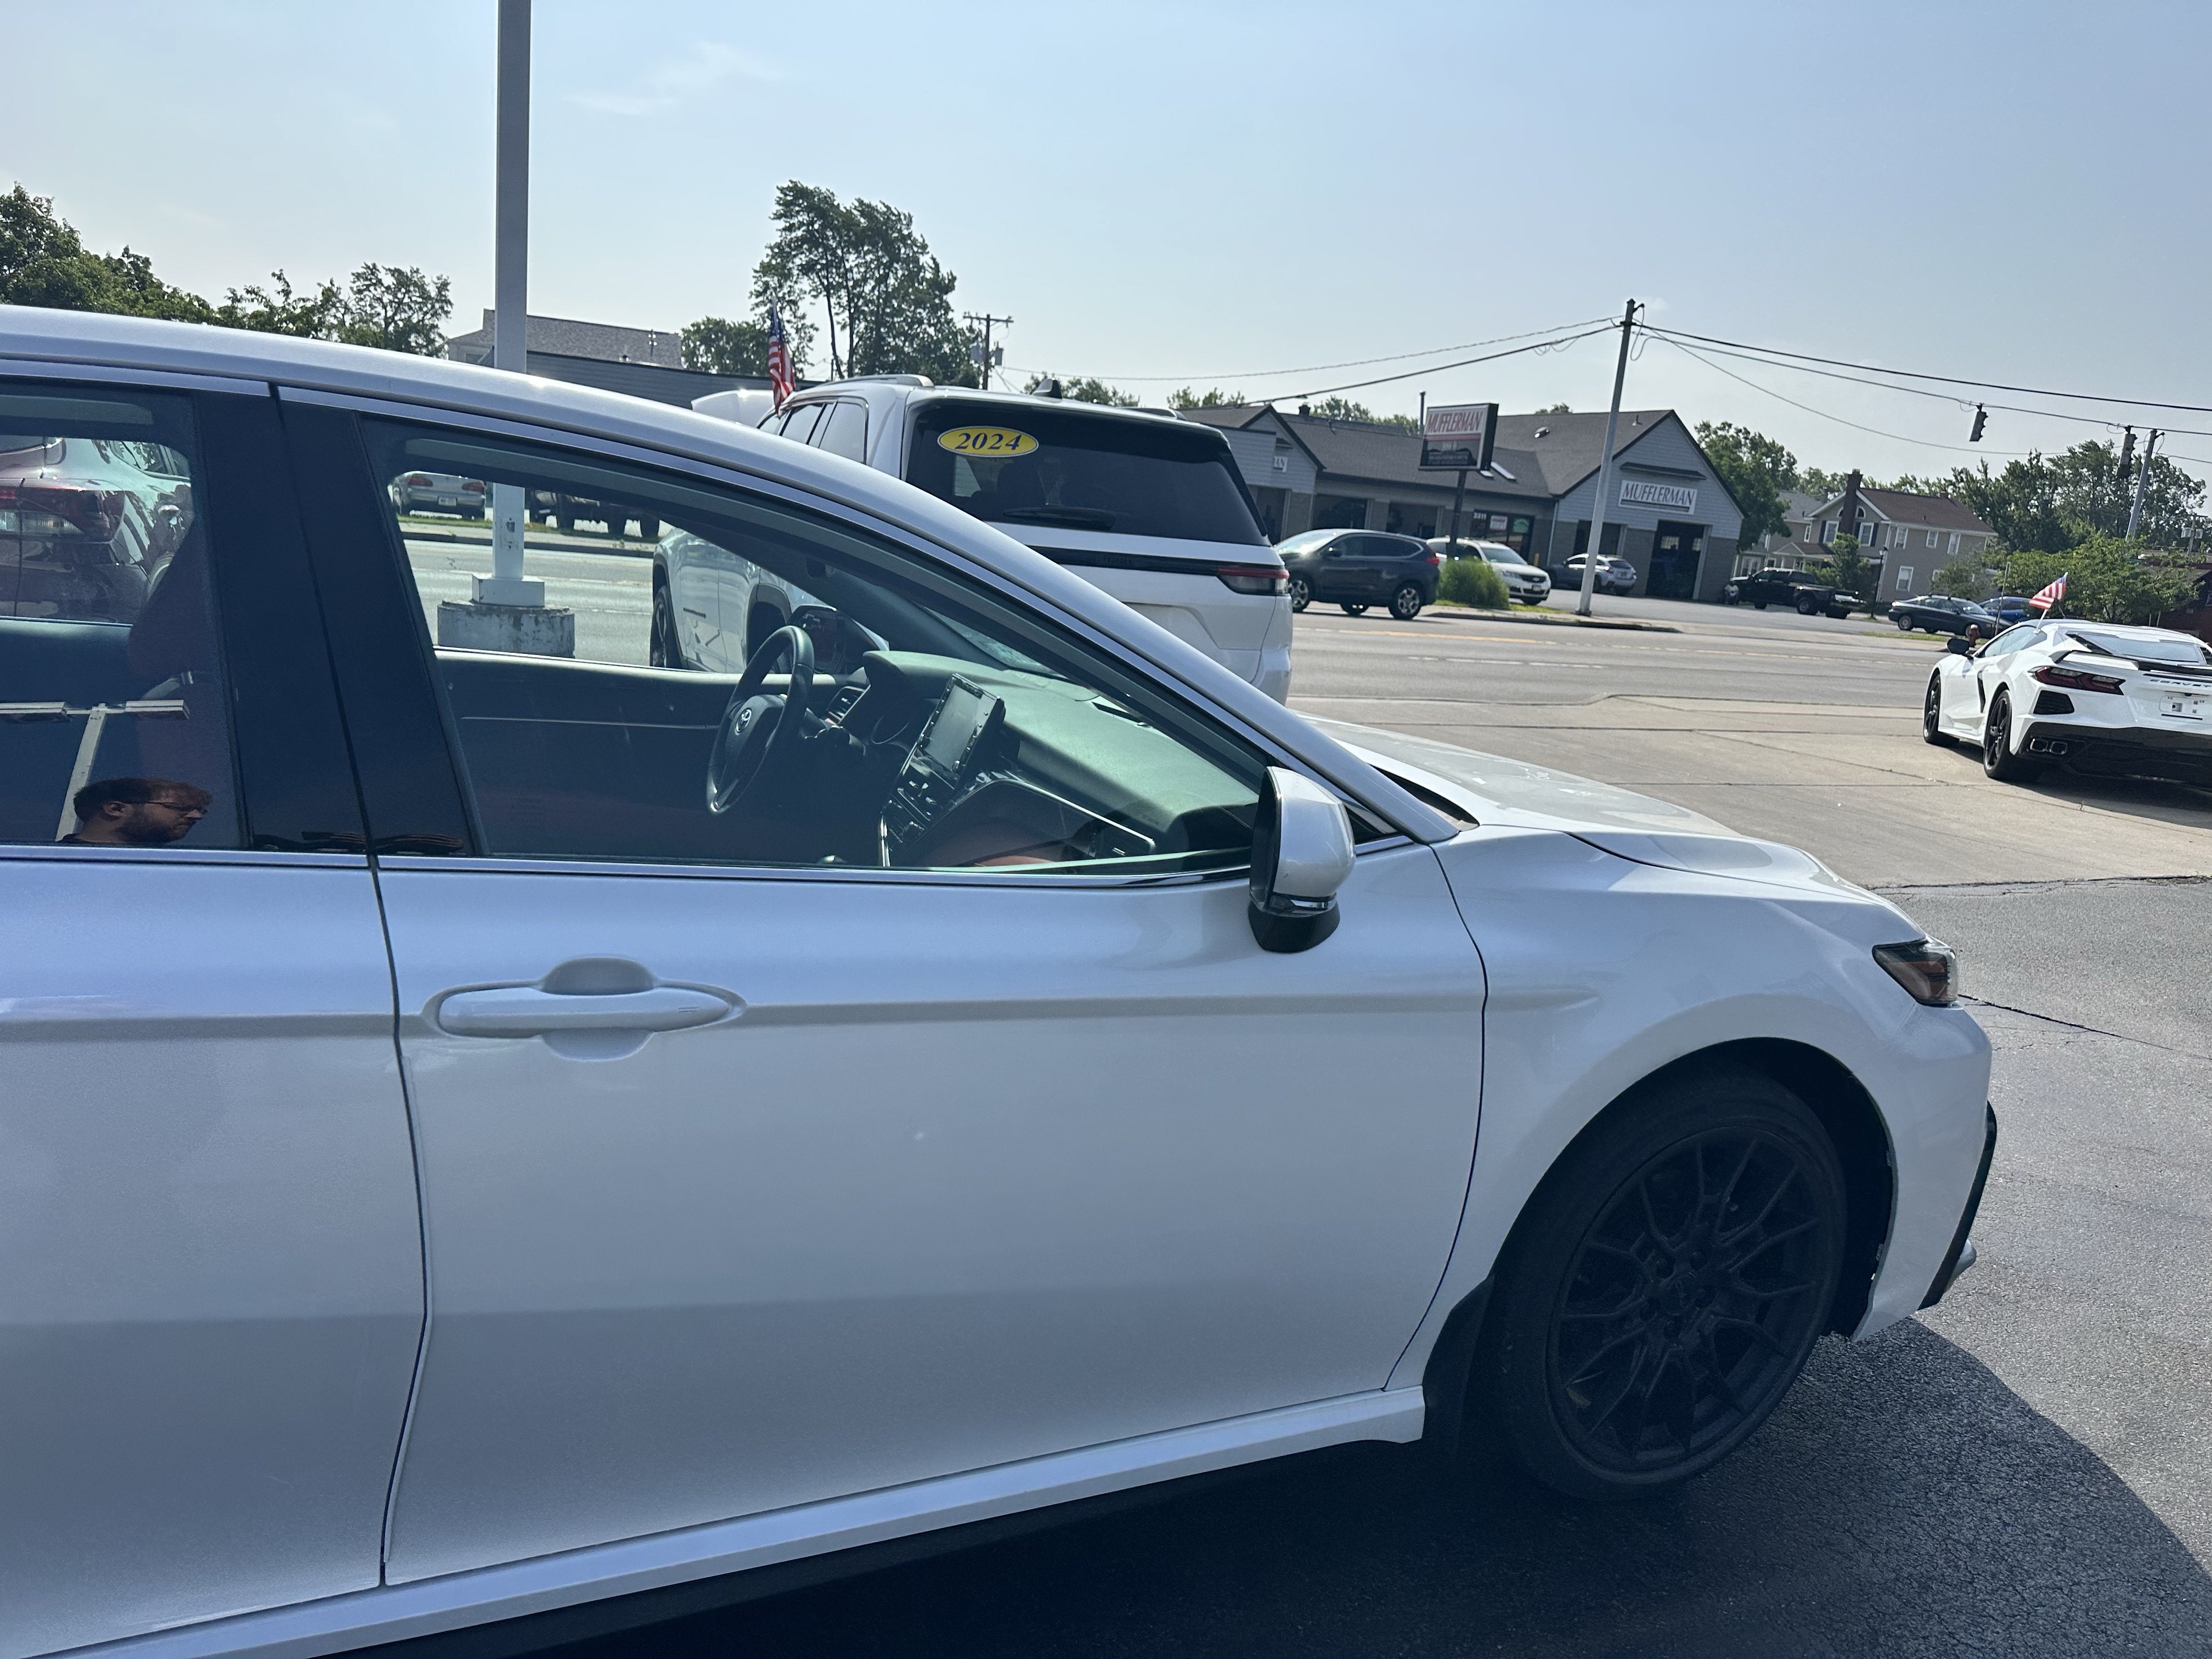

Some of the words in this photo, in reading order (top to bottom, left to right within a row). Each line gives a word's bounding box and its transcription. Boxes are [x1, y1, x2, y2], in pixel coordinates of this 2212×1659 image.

[1427, 411, 1483, 433] MUFFLERMAN
[955, 432, 1023, 450] 2024
[1622, 482, 1695, 505] MUFFLERMAN
